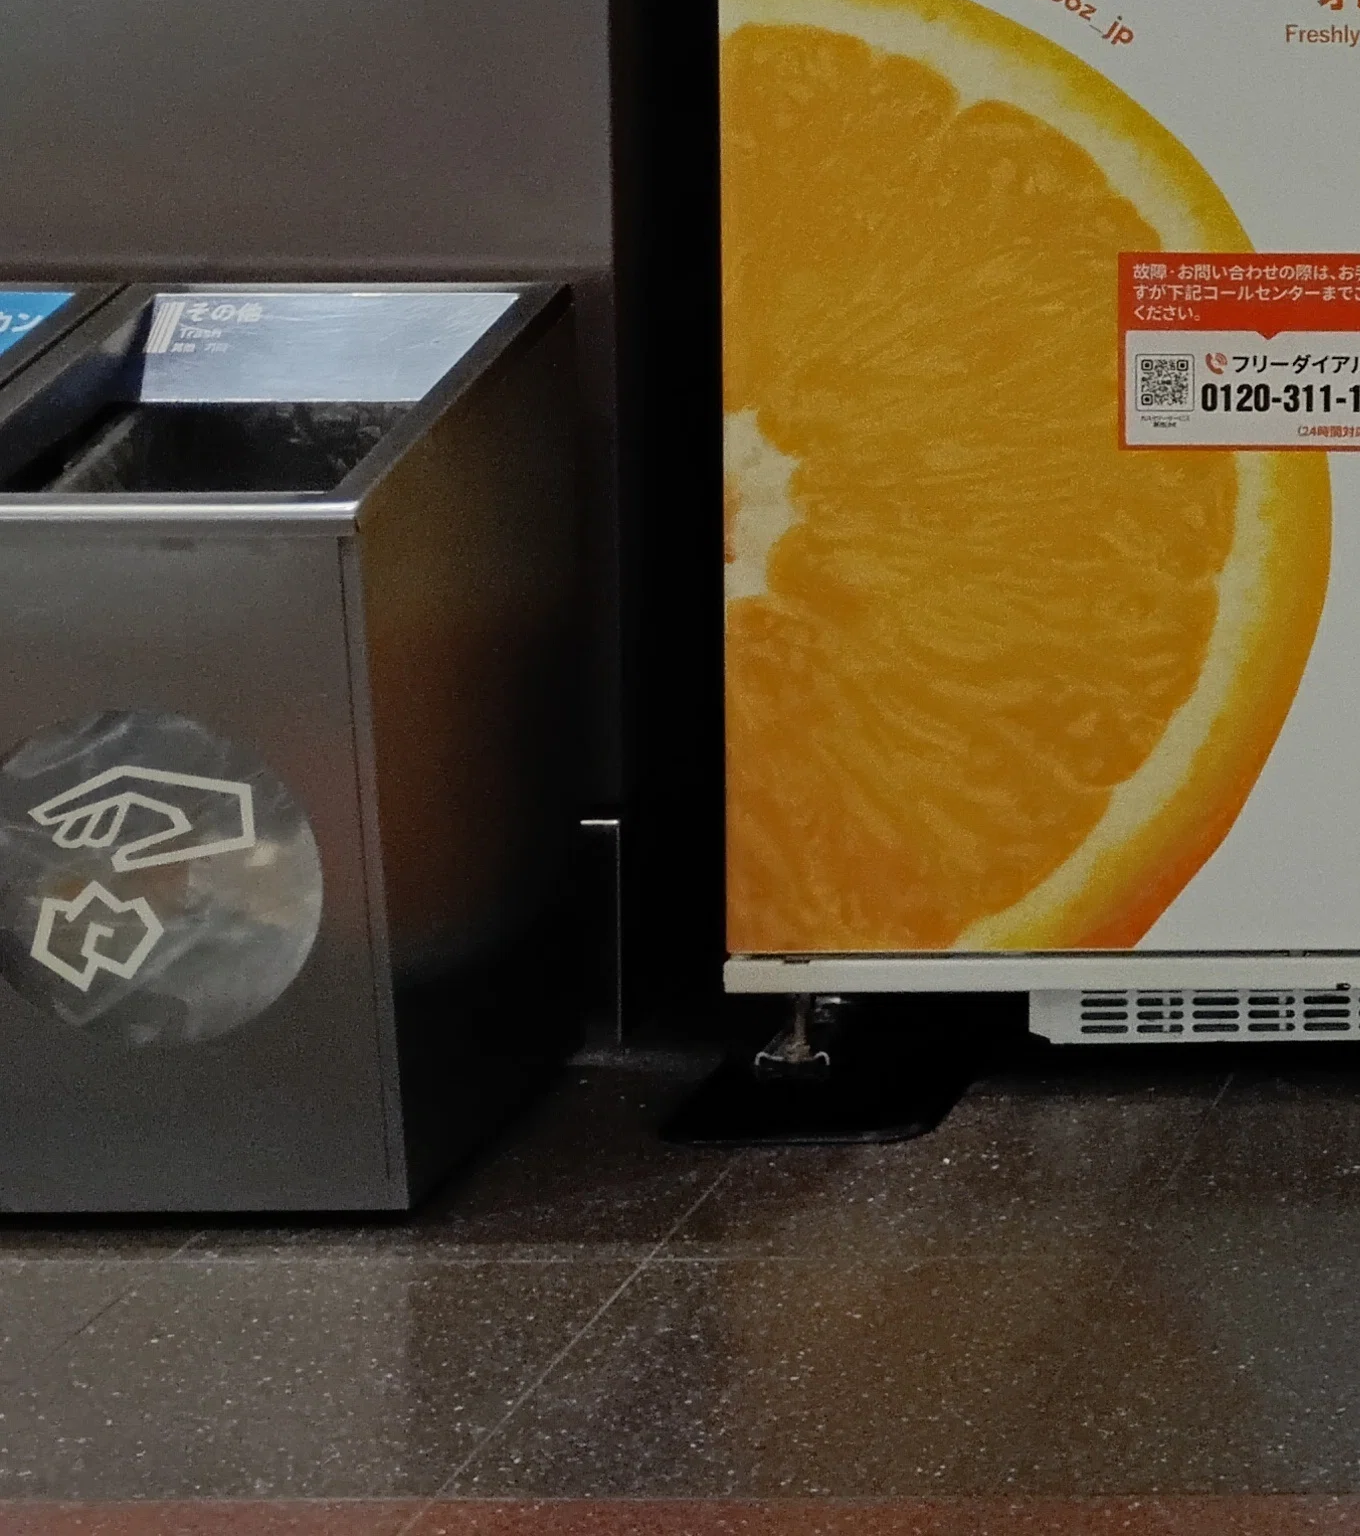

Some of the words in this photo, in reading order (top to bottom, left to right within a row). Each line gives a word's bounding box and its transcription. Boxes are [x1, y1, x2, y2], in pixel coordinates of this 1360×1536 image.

[186, 302, 263, 323] その他
[1133, 306, 1201, 322] ください。
